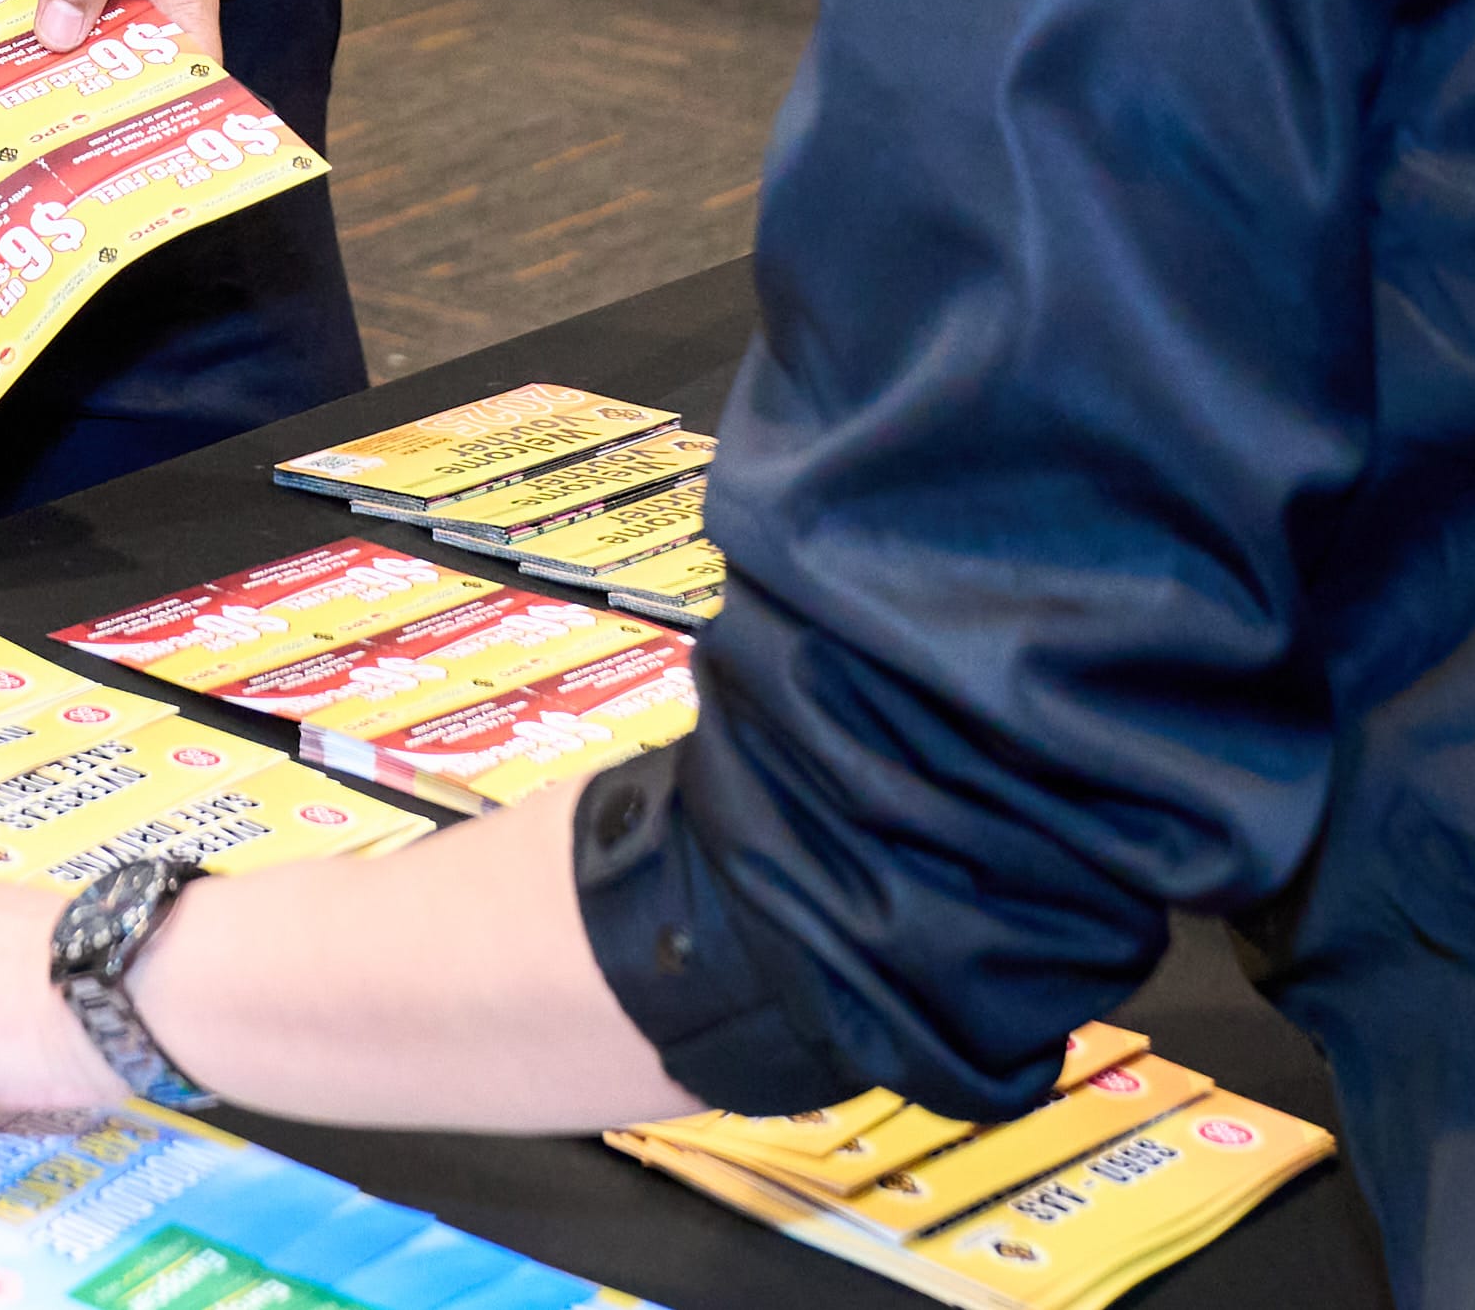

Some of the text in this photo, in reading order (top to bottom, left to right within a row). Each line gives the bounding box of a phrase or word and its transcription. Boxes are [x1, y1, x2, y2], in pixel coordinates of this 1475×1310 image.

[100, 7, 126, 21] with
[48, 59, 97, 88] SPC
[89, 23, 178, 88] $6
[77, 72, 113, 96] OFF
[168, 107, 200, 125] every
[198, 97, 225, 112] with
[30, 125, 69, 143] SPC
[72, 138, 123, 165] purchase
[110, 116, 201, 158] For AA Members
[121, 129, 145, 144] fuel
[176, 114, 279, 188] $6 OFF
[88, 148, 196, 203] SPC FUEL
[7, 184, 33, 205] with
[128, 219, 171, 243] SPC
[417, 383, 586, 437] 2025
[435, 421, 600, 474] Welcome
[453, 414, 595, 457] Voucher
[511, 459, 679, 508] Welcome
[531, 448, 671, 489] Voucher
[608, 486, 706, 524] oucher
[598, 504, 704, 544] elcome
[346, 557, 439, 592] $6
[193, 605, 291, 640] $6
[502, 604, 597, 636] $6
[350, 657, 447, 690] $6
[513, 711, 614, 750] $6
[53, 740, 133, 776] SAFE
[0, 765, 147, 829] OVERSEAS
[46, 792, 261, 880] SAFE DRIVING
[163, 819, 272, 864] OVERS
